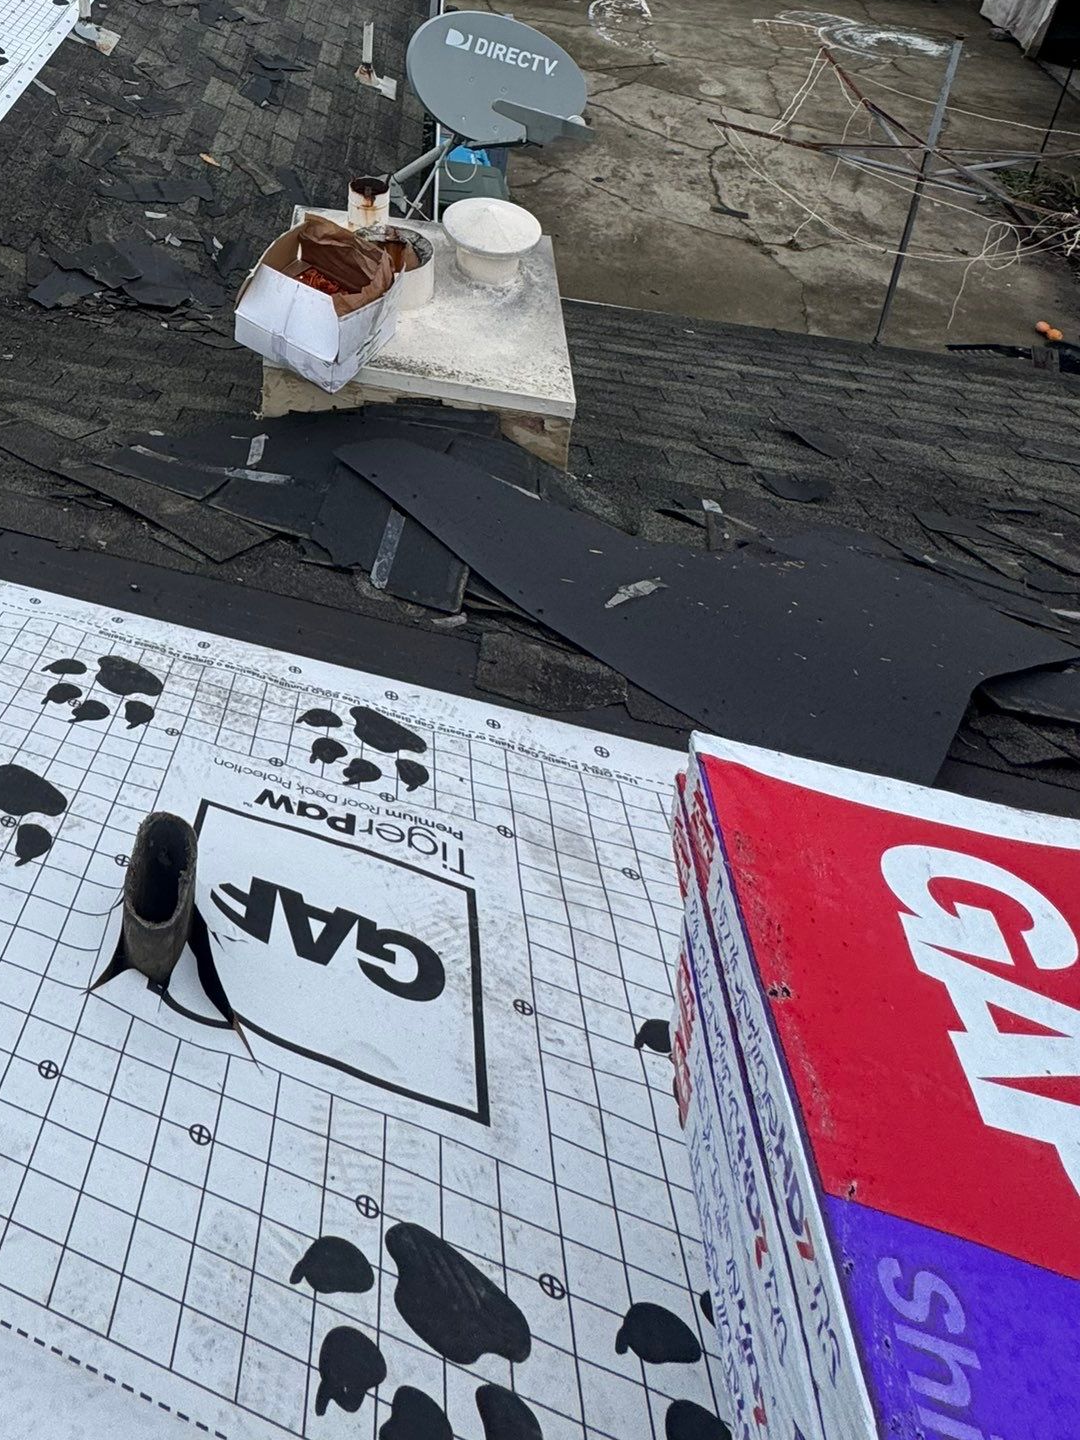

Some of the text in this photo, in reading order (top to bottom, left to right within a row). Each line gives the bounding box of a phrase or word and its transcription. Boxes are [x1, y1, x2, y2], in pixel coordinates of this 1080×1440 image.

[474, 37, 559, 76] DIRECTV
[214, 757, 463, 841] Premium Roof Deck Protection
[210, 876, 446, 1002] GAF
